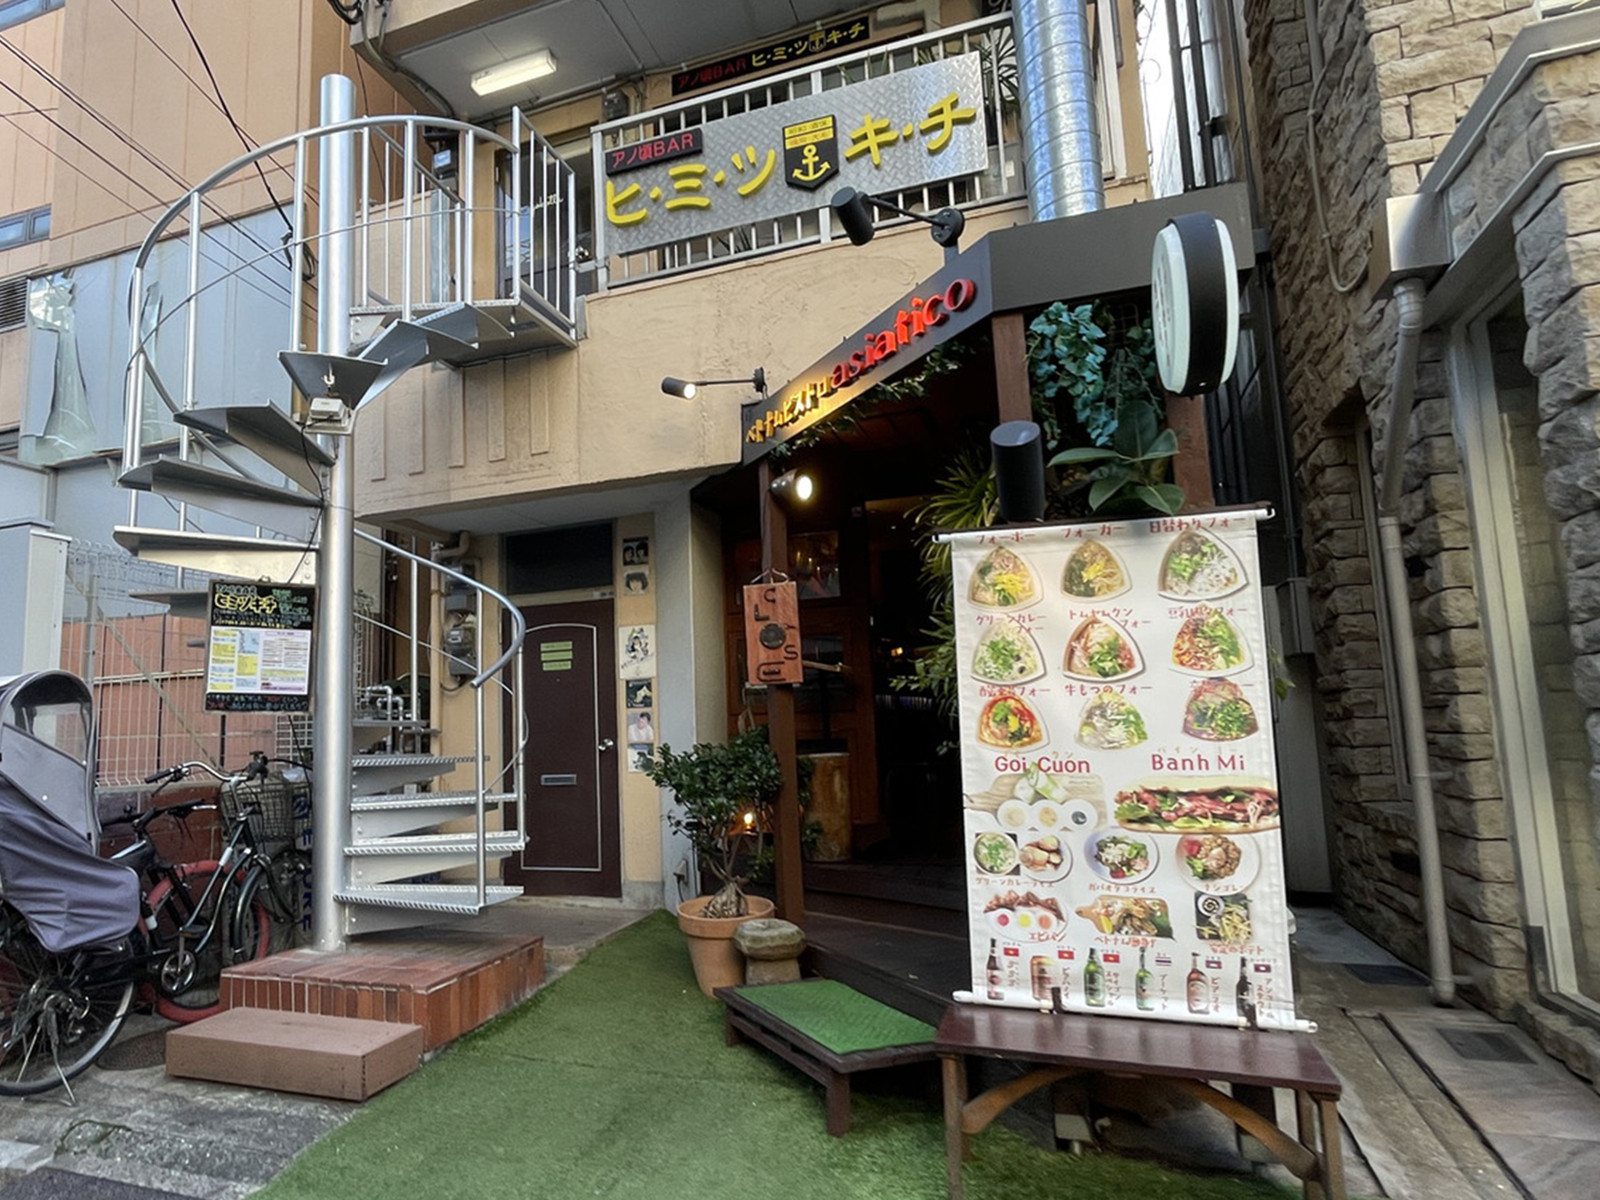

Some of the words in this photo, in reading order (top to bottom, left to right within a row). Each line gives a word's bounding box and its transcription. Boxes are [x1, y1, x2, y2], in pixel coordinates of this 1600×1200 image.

[831, 277, 978, 390] asiatico
[1149, 517, 1247, 534] 日替わりフォー
[994, 755, 1028, 773] Goi
[1037, 756, 1091, 774] Cuon
[1151, 753, 1210, 771] Banh
[1217, 754, 1246, 771] Mi
